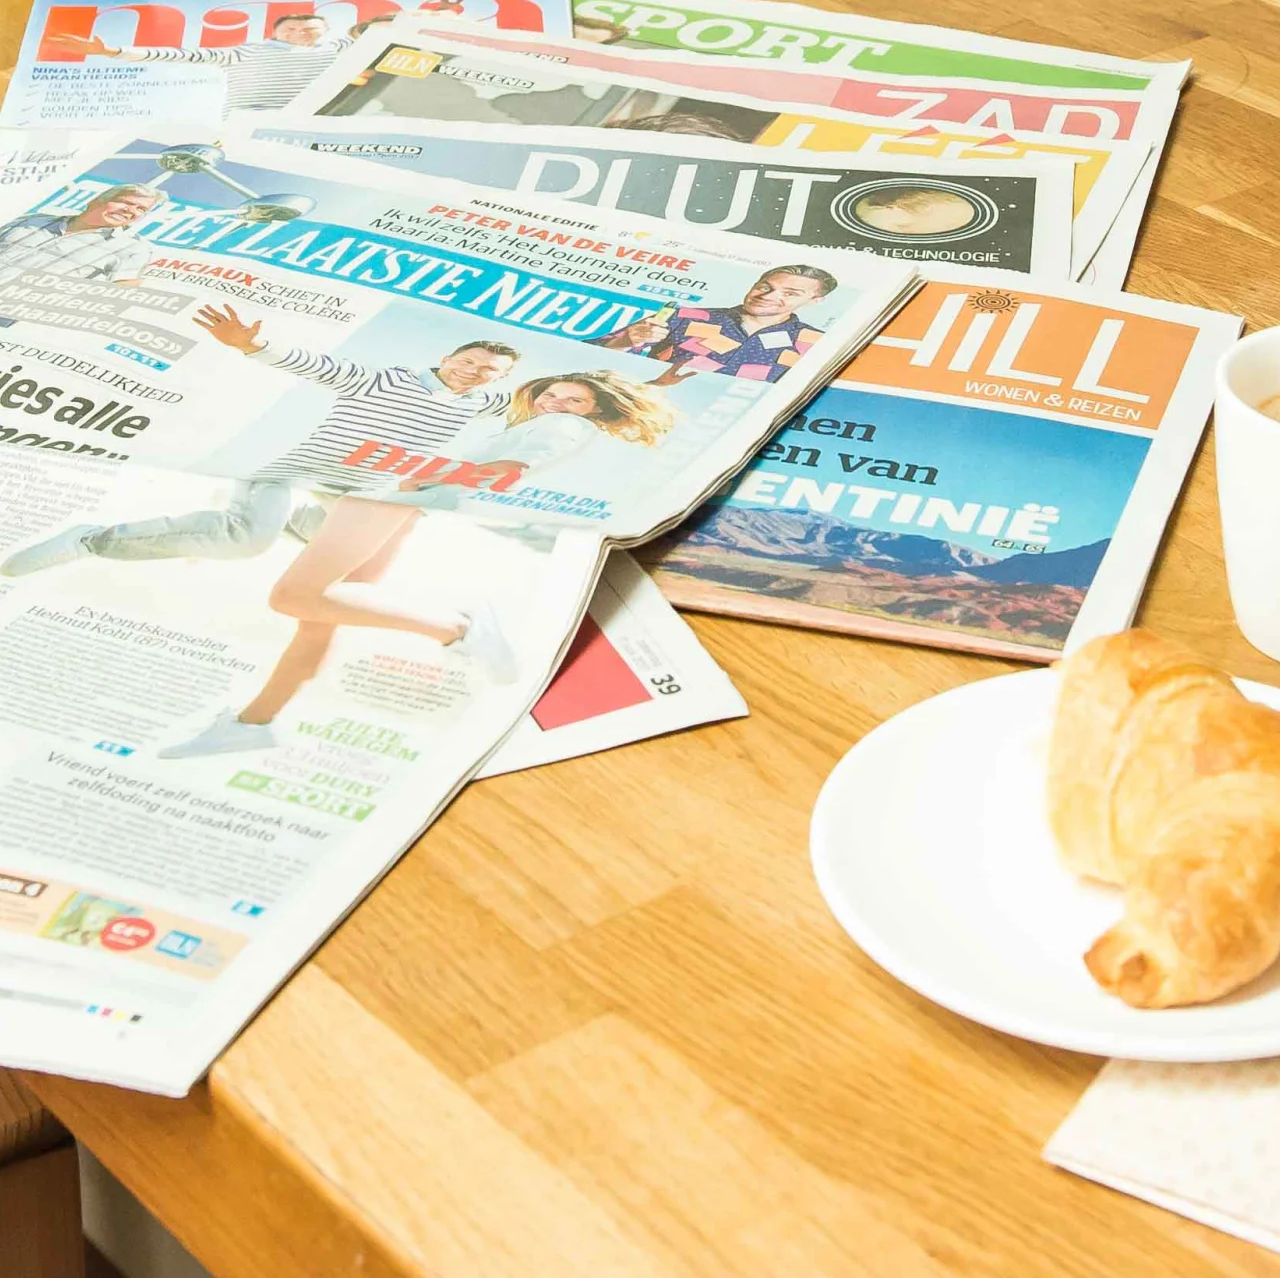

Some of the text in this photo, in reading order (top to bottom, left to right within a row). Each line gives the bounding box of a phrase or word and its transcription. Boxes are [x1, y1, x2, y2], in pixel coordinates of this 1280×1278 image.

[438, 65, 535, 89] WEEKEND
[317, 142, 421, 155] WEEKEND
[469, 198, 601, 232] NATIONALE EDITIE
[228, 218, 485, 303] LAATSTE
[371, 218, 417, 242] Maar
[456, 236, 547, 269] Martine
[548, 259, 631, 289] Tanghe
[383, 207, 406, 222] Ik
[406, 211, 435, 232] wil
[437, 218, 489, 243] zelfs
[647, 268, 709, 292] doen.
[427, 204, 515, 235] PETER
[515, 222, 572, 246] VAN
[578, 237, 612, 253] DE
[615, 246, 697, 273] VEIRE
[881, 248, 1001, 263] TECHNOLOGIE
[20, 274, 182, 311] «Degoutant.
[142, 268, 183, 284] EEN
[184, 274, 283, 310] BRUSSELSE
[148, 258, 350, 308] ANCIAUX SCHIET IN
[22, 343, 185, 406] DUIDELIJKHEID
[53, 396, 153, 440] alle
[963, 379, 1143, 423] WONEN & REIZEN
[340, 438, 531, 494] nina
[836, 452, 940, 486] van
[469, 491, 614, 522] ZOMERNUMMER
[521, 484, 613, 511] EXTRA DIK
[25, 604, 258, 673] Helmut Kohl (87) overleden
[650, 673, 682, 695] 39
[46, 750, 329, 843] Vriend voert zelf onderzoek naar
[66, 773, 276, 845] zelfdoding na naaktfoto
